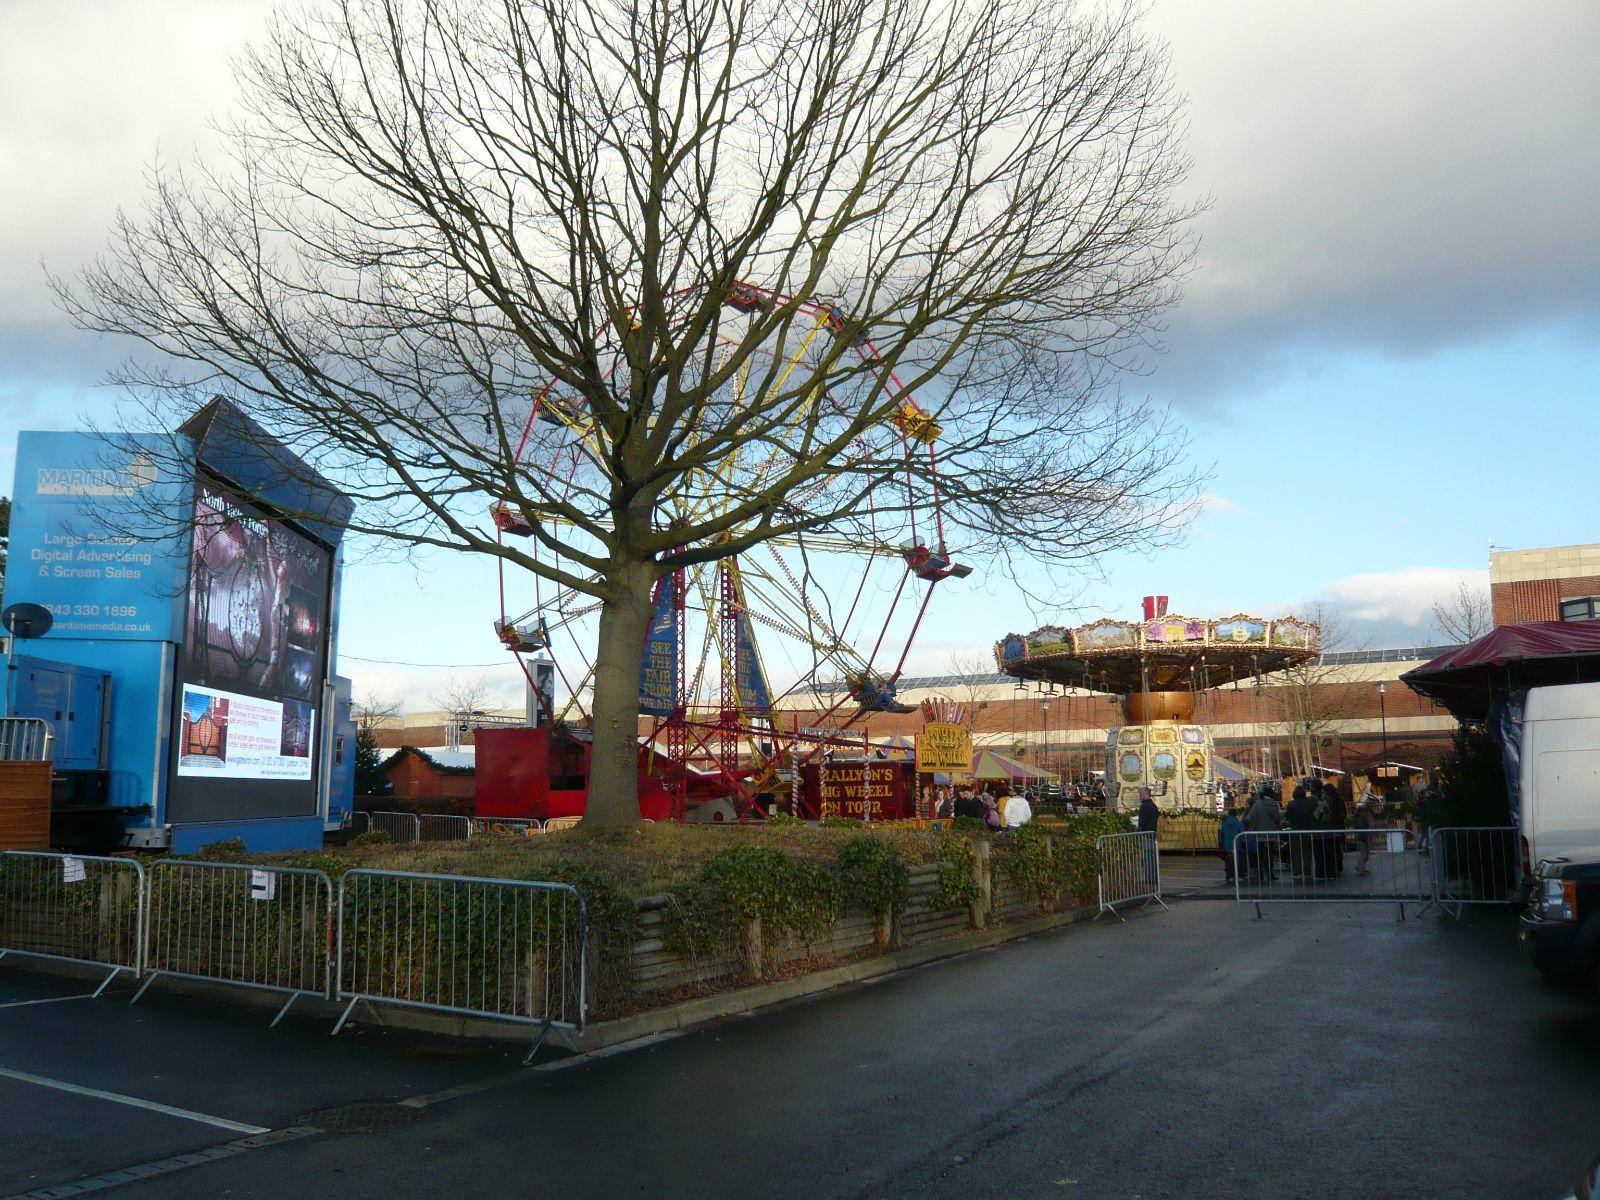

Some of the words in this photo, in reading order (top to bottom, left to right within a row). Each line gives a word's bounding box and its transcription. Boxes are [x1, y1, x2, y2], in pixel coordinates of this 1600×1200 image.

[202, 488, 225, 512] North
[44, 533, 82, 547] Large
[31, 548, 73, 563] Digital
[77, 549, 152, 566] Advertising
[39, 565, 50, 577] &
[53, 566, 100, 578] Screen
[105, 567, 141, 579] Sales
[40, 603, 71, 616] 843
[73, 604, 99, 616] 330
[103, 606, 137, 617] 1896
[651, 641, 672, 655] SEE
[650, 655, 672, 669] THE
[645, 668, 672, 683] FAIR
[643, 683, 673, 697] FROM
[656, 699, 674, 711] AIR
[844, 784, 893, 798] WHEEL
[845, 800, 883, 814] TOUR
